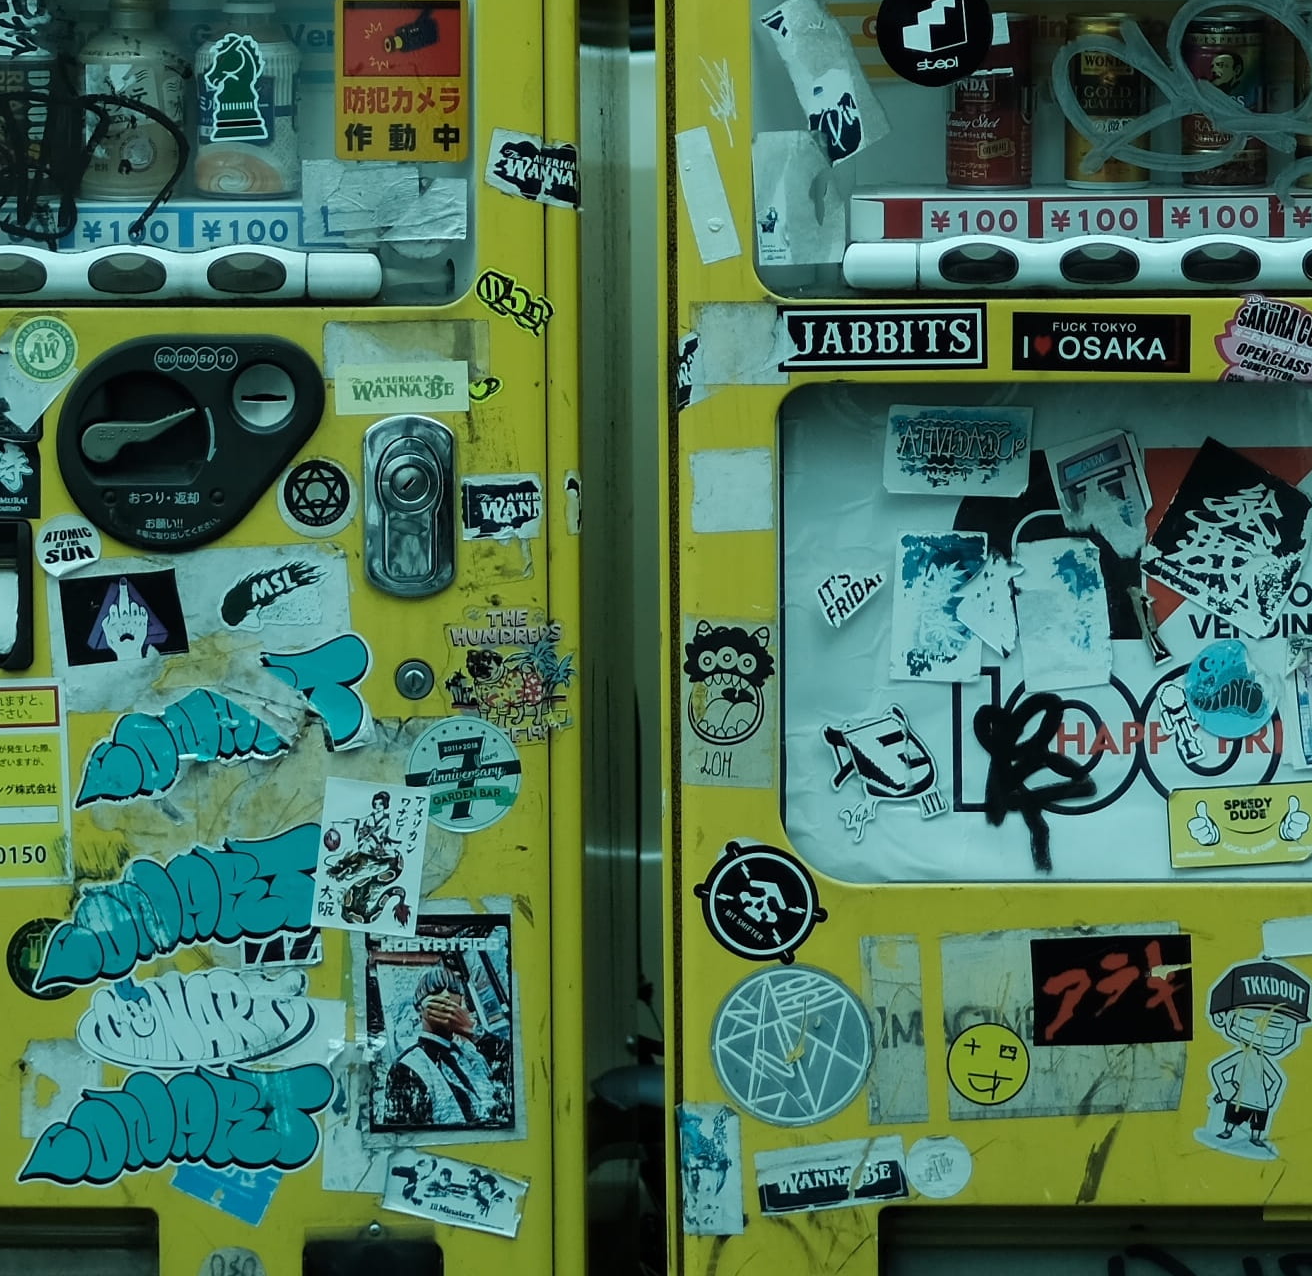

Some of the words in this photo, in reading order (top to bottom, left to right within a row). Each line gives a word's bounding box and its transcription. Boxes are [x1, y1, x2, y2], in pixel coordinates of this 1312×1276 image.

[343, 86, 461, 114] 防犯カメラ
[344, 124, 461, 152] 作動中
[1172, 206, 1258, 228] ¥100
[202, 220, 288, 245] ¥100
[1052, 322, 1087, 333] FUCK
[1092, 322, 1137, 333] TOKYO
[1238, 302, 1298, 342] SAKURA
[795, 319, 972, 355] JABBITS
[1023, 335, 1029, 359] I
[1057, 335, 1167, 361] OSAKA
[157, 354, 177, 364] 500
[178, 354, 196, 364] 100
[198, 354, 215, 364] 50
[220, 354, 233, 364] 10
[1236, 342, 1270, 366] OPEN
[1271, 354, 1312, 376] CLASS
[375, 374, 431, 384] AMERICAN
[128, 490, 200, 506] おつり・返却
[43, 526, 93, 544] ATOMIC
[44, 545, 95, 565] SUN
[251, 569, 299, 602] MSL
[486, 610, 529, 628] THE
[450, 624, 563, 647] HUNDREDS
[425, 762, 506, 788] Anniversary
[432, 789, 474, 806] GARDEN
[477, 787, 502, 801] BAR
[1223, 796, 1273, 811] SPEEDY
[1229, 808, 1267, 821] DUDE
[1241, 975, 1306, 1003] TKKDOUT
